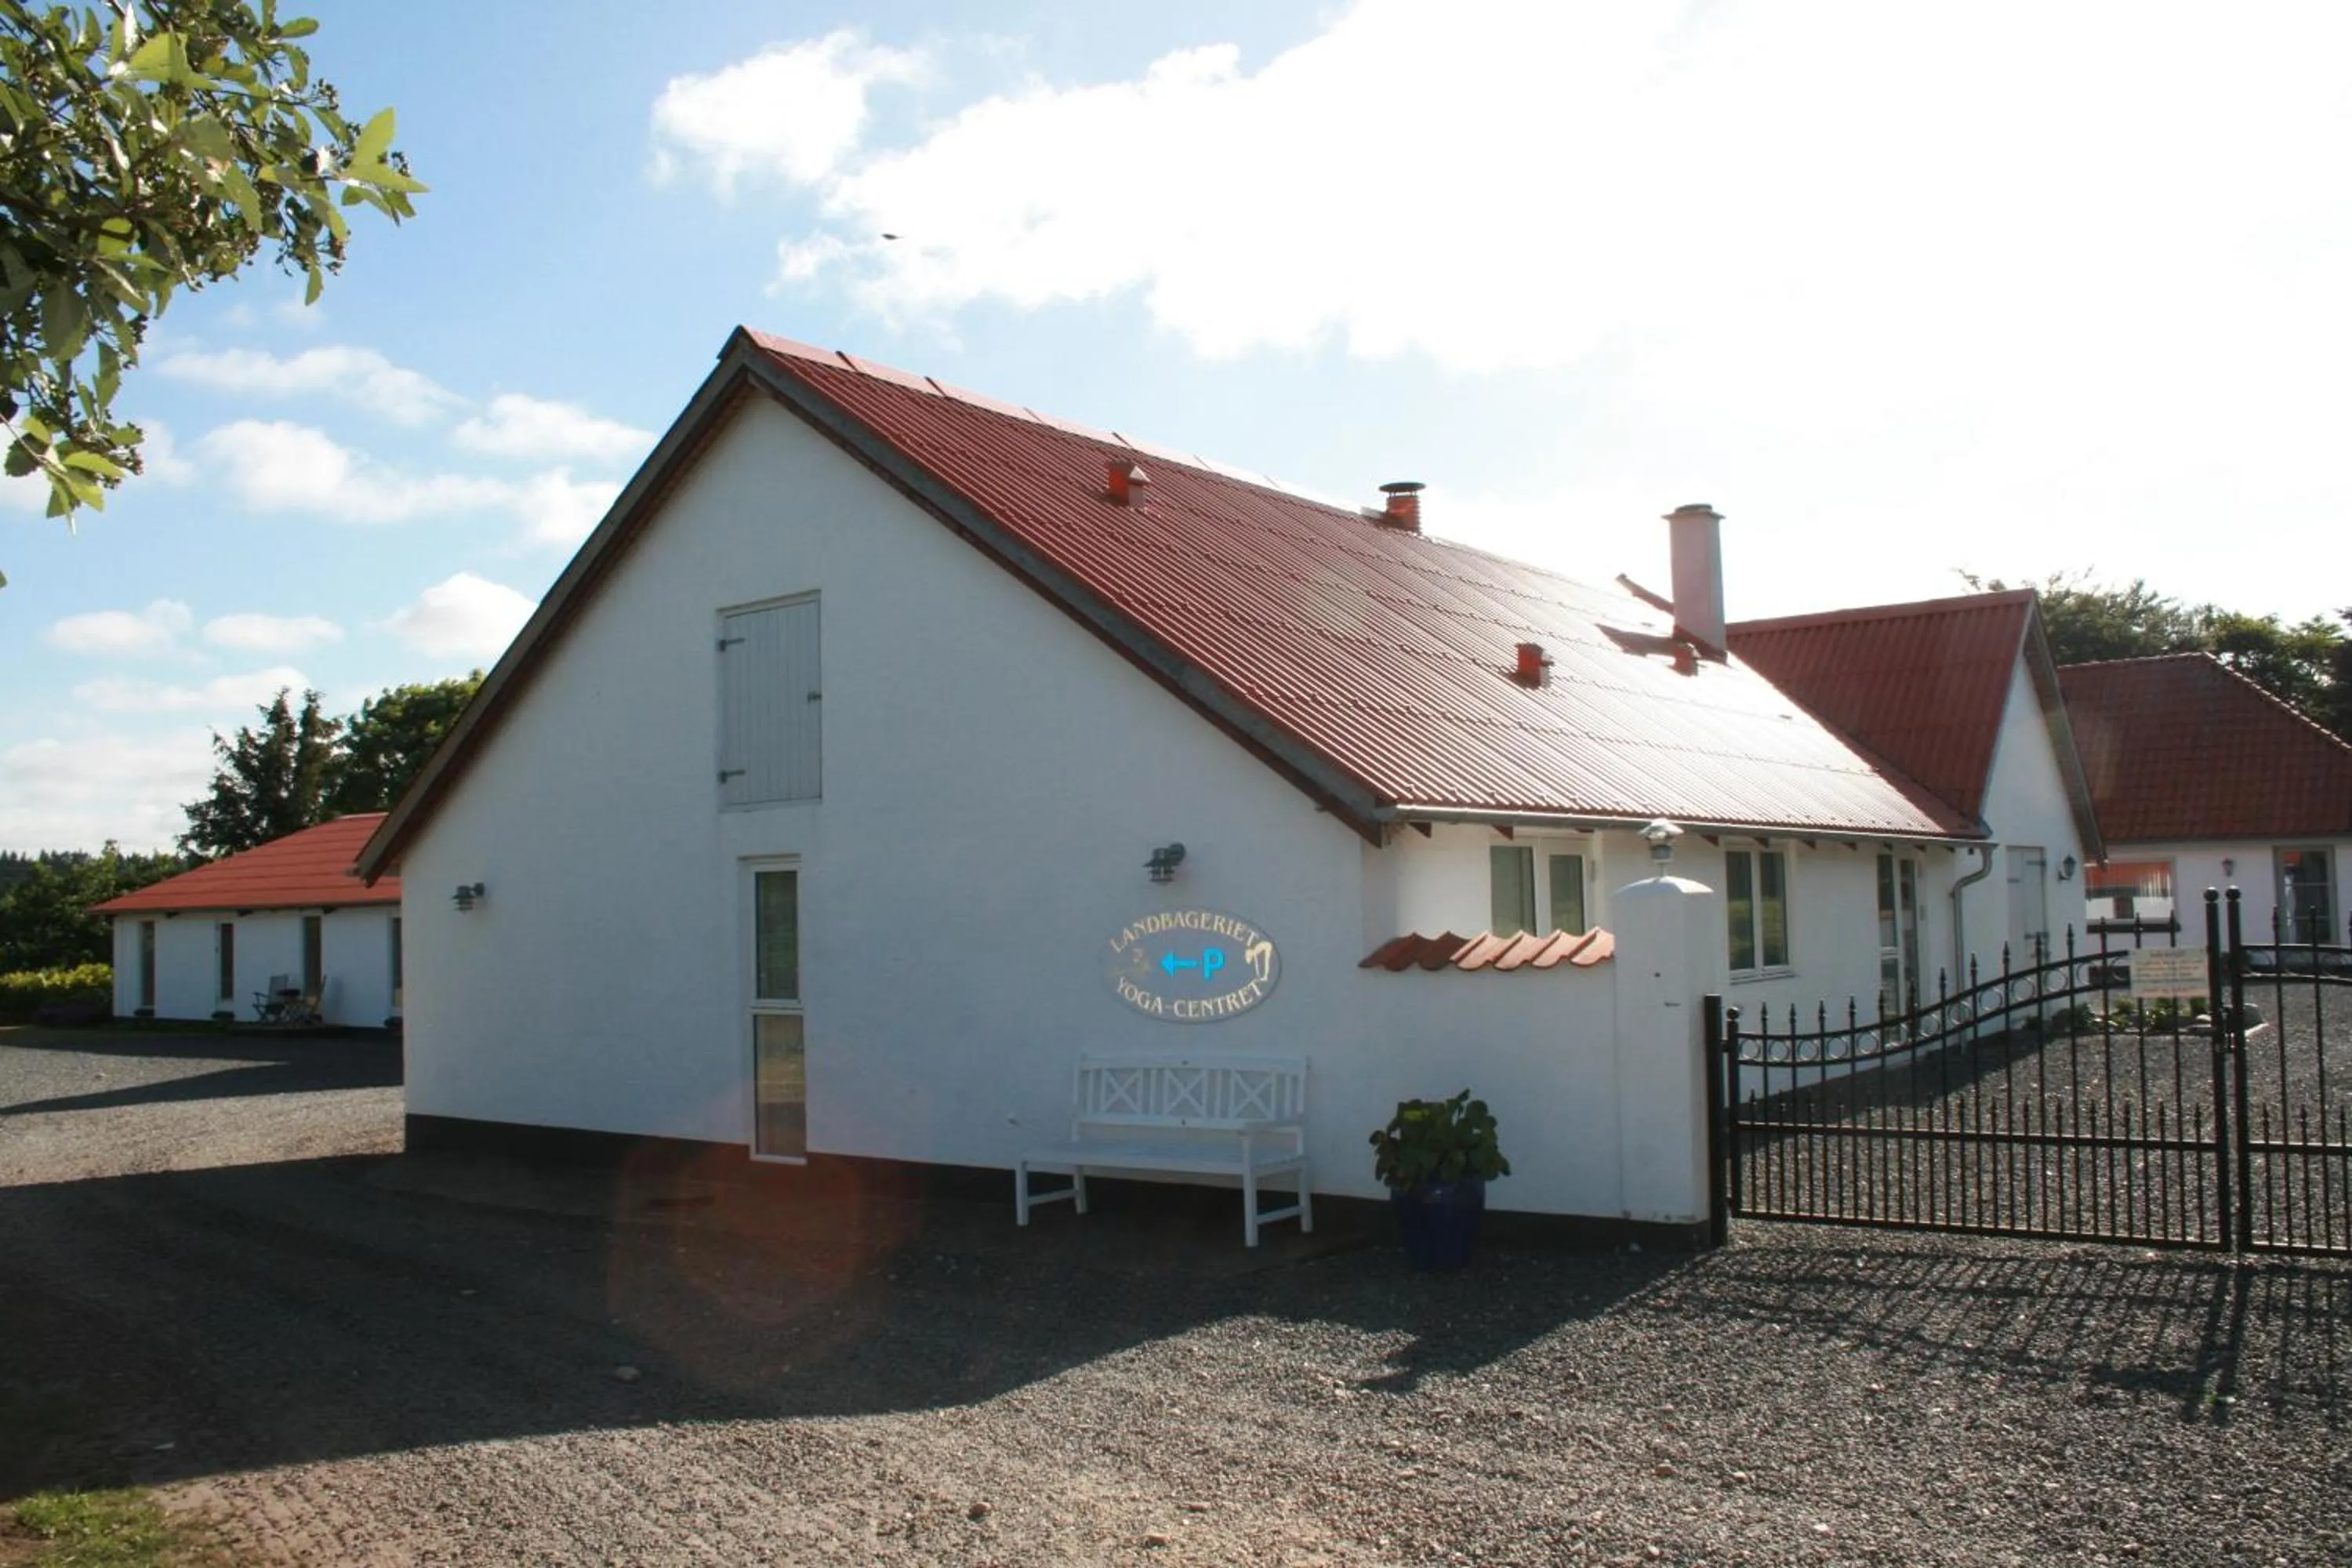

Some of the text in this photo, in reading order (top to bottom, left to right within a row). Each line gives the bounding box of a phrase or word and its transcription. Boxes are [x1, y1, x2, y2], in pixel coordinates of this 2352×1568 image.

[1110, 910, 1259, 953] LANDBAGERIET
[1203, 947, 1225, 981] P
[1116, 976, 1263, 1018] YOGA-CENTRET
